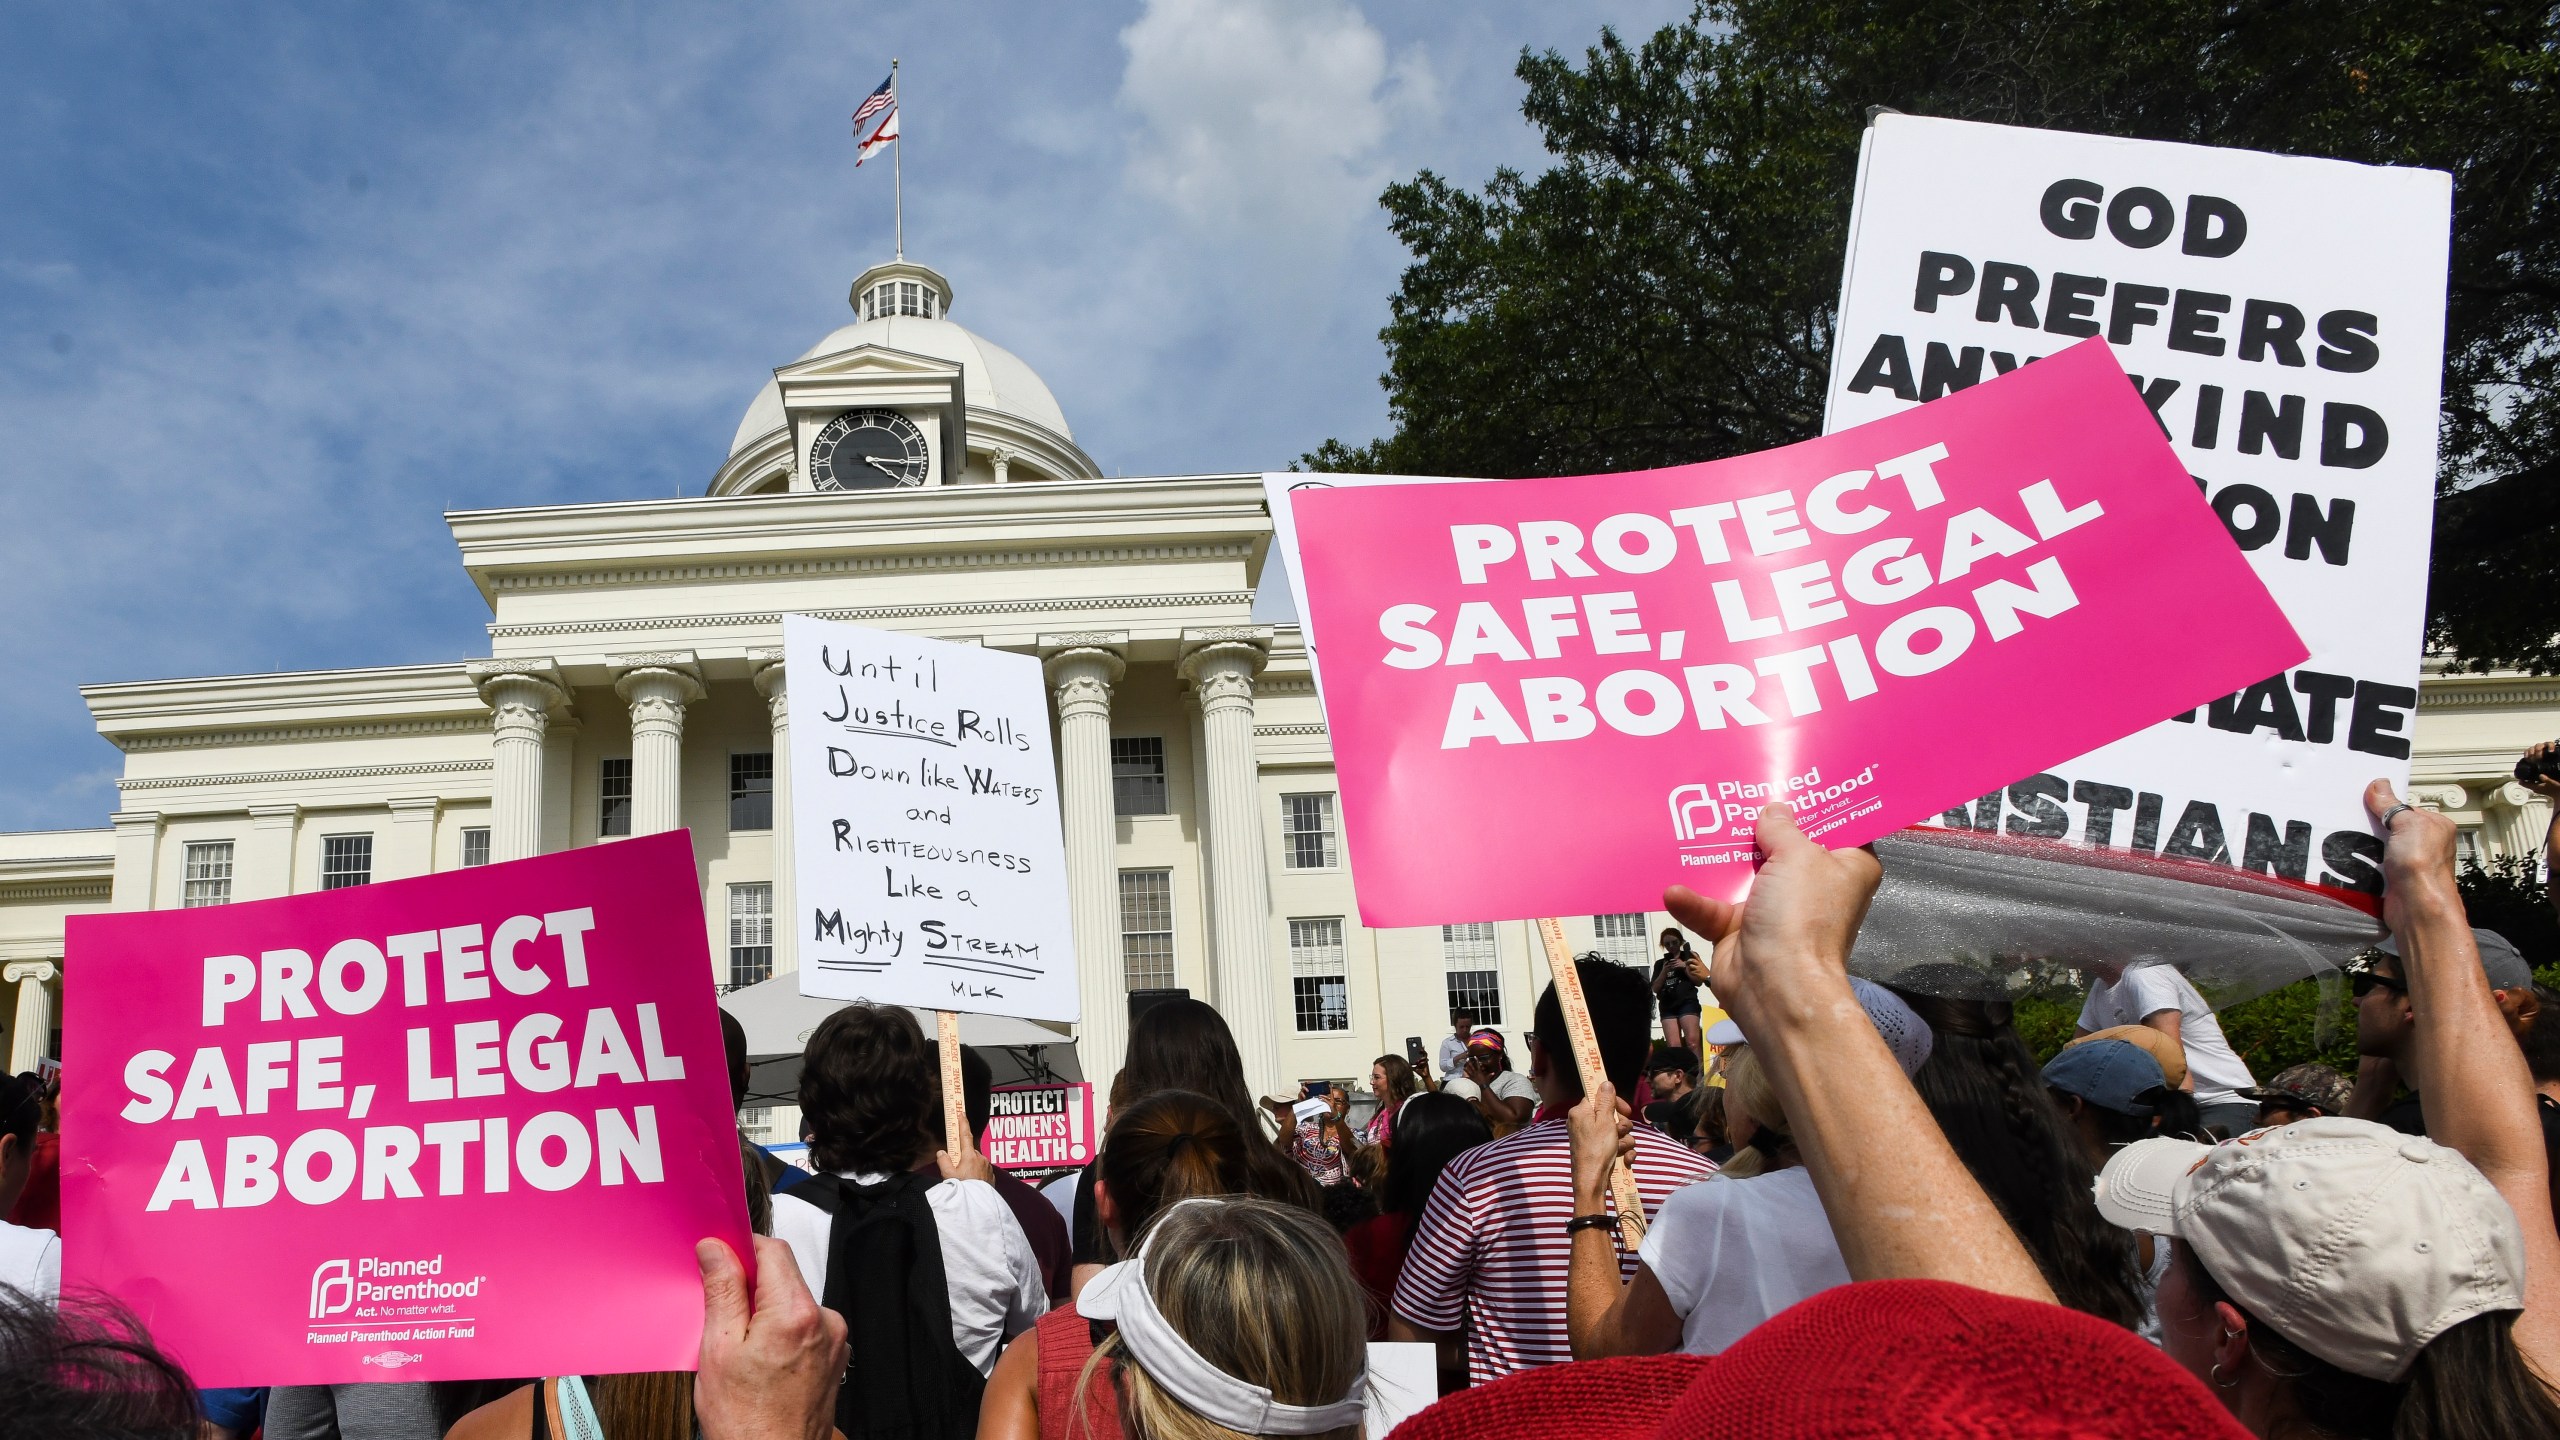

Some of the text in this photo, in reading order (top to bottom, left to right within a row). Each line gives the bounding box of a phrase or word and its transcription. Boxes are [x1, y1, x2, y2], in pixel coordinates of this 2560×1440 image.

[2039, 178, 2248, 259] GOD
[1913, 250, 2381, 374] PREFERS
[1450, 441, 1949, 585] PROTECT
[2190, 474, 2356, 568] ON
[1378, 477, 2105, 670] SAFE, LEGAL
[822, 645, 937, 692] Until
[1440, 556, 2081, 749] ABORTION
[823, 685, 1031, 752] Justice Rolls
[827, 746, 911, 785] Down
[921, 758, 960, 791] like
[1718, 766, 1822, 800] Planned
[906, 805, 951, 826] and
[1820, 797, 1854, 815] what.
[1680, 850, 1731, 867] Planned
[1807, 816, 1848, 840] Action
[1850, 800, 1883, 821] Fund
[957, 890, 978, 908] a
[201, 906, 595, 1027] PROTECT
[1564, 964, 1582, 1001] DEPOT
[950, 981, 1004, 999] MLK
[1576, 1007, 1594, 1042] HOME
[120, 1002, 687, 1125] SAFE, LEGAL
[949, 1033, 959, 1063] DEPOT
[1588, 1048, 1602, 1073] THE
[952, 1067, 962, 1095] HOME
[989, 1089, 1064, 1116] PROTECT
[989, 1114, 1067, 1139] WOMEN'S
[145, 1104, 665, 1213] ABORTION
[358, 1254, 442, 1278] Planned
[357, 1276, 479, 1301] Parenthood
[355, 1303, 456, 1317] Act. No matter what.
[307, 1326, 475, 1344] Planned Parenthood Action Fund
[412, 1353, 423, 1363] 21
